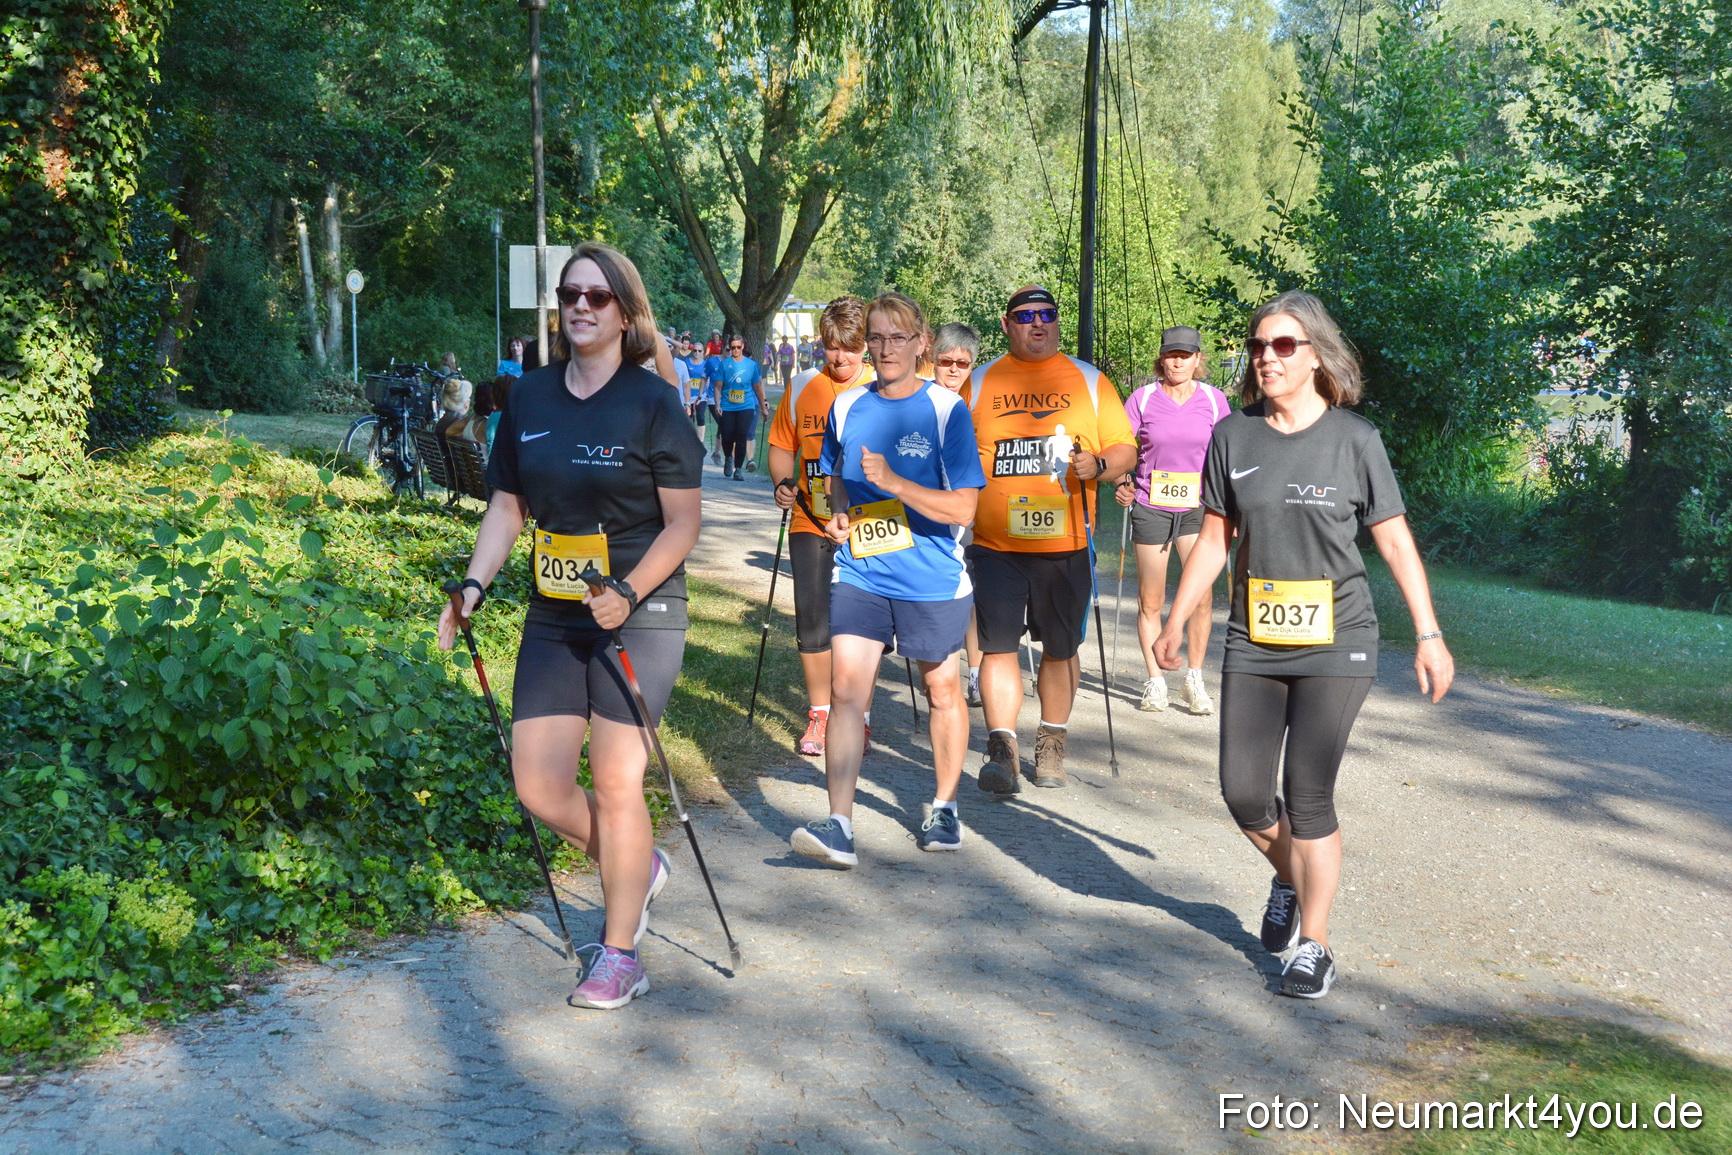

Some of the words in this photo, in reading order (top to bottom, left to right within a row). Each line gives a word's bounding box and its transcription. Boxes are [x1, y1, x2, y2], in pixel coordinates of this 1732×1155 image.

[993, 395, 1002, 410] BIT
[1003, 393, 1071, 409] WINGS
[803, 414, 812, 429] BIT
[997, 439, 1042, 457] #LÄUFT
[995, 460, 1014, 475] BEI
[1016, 459, 1041, 474] UNS
[1161, 484, 1188, 497] 468
[1304, 500, 1335, 508] UNLIMITED
[1021, 511, 1054, 527] 196
[855, 518, 899, 543] 1960
[551, 580, 566, 588] Baier
[1259, 603, 1320, 626] 2037
